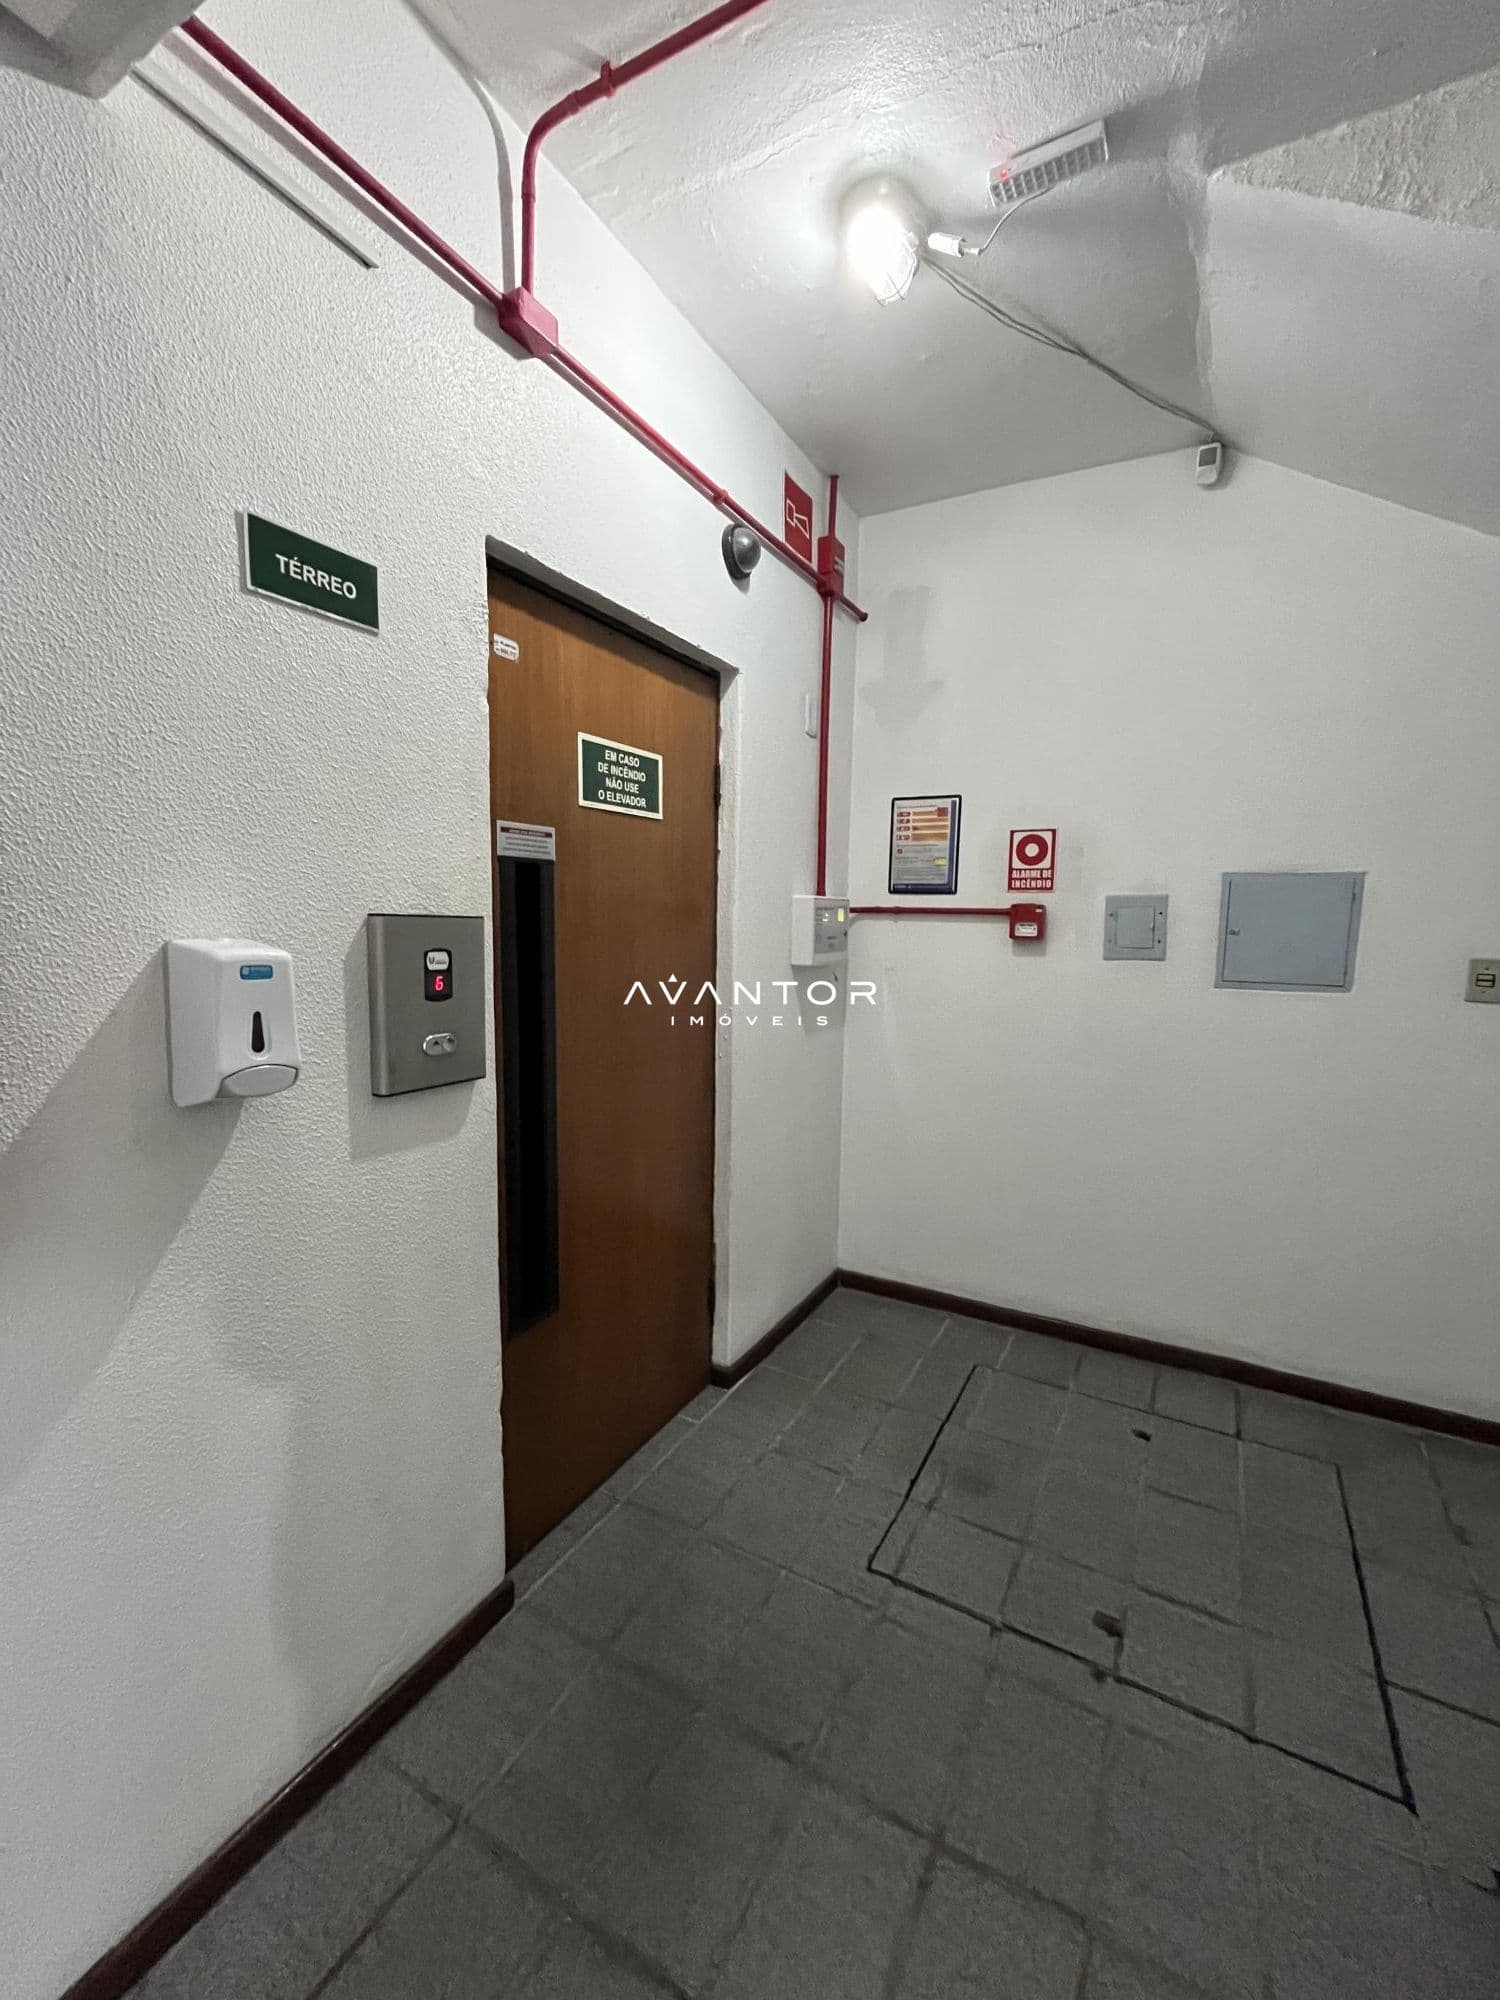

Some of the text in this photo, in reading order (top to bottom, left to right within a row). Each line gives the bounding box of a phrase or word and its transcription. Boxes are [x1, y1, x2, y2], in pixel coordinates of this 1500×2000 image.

[275, 553, 357, 599] TÉRREO
[605, 750, 640, 767] EM CASO
[597, 762, 646, 782] DE INCÊNDIO
[605, 776, 639, 794] NÃO USE
[598, 789, 647, 808] O ELEVADOR
[1011, 869, 1052, 878] ALARME DE
[435, 975, 444, 991] 6
